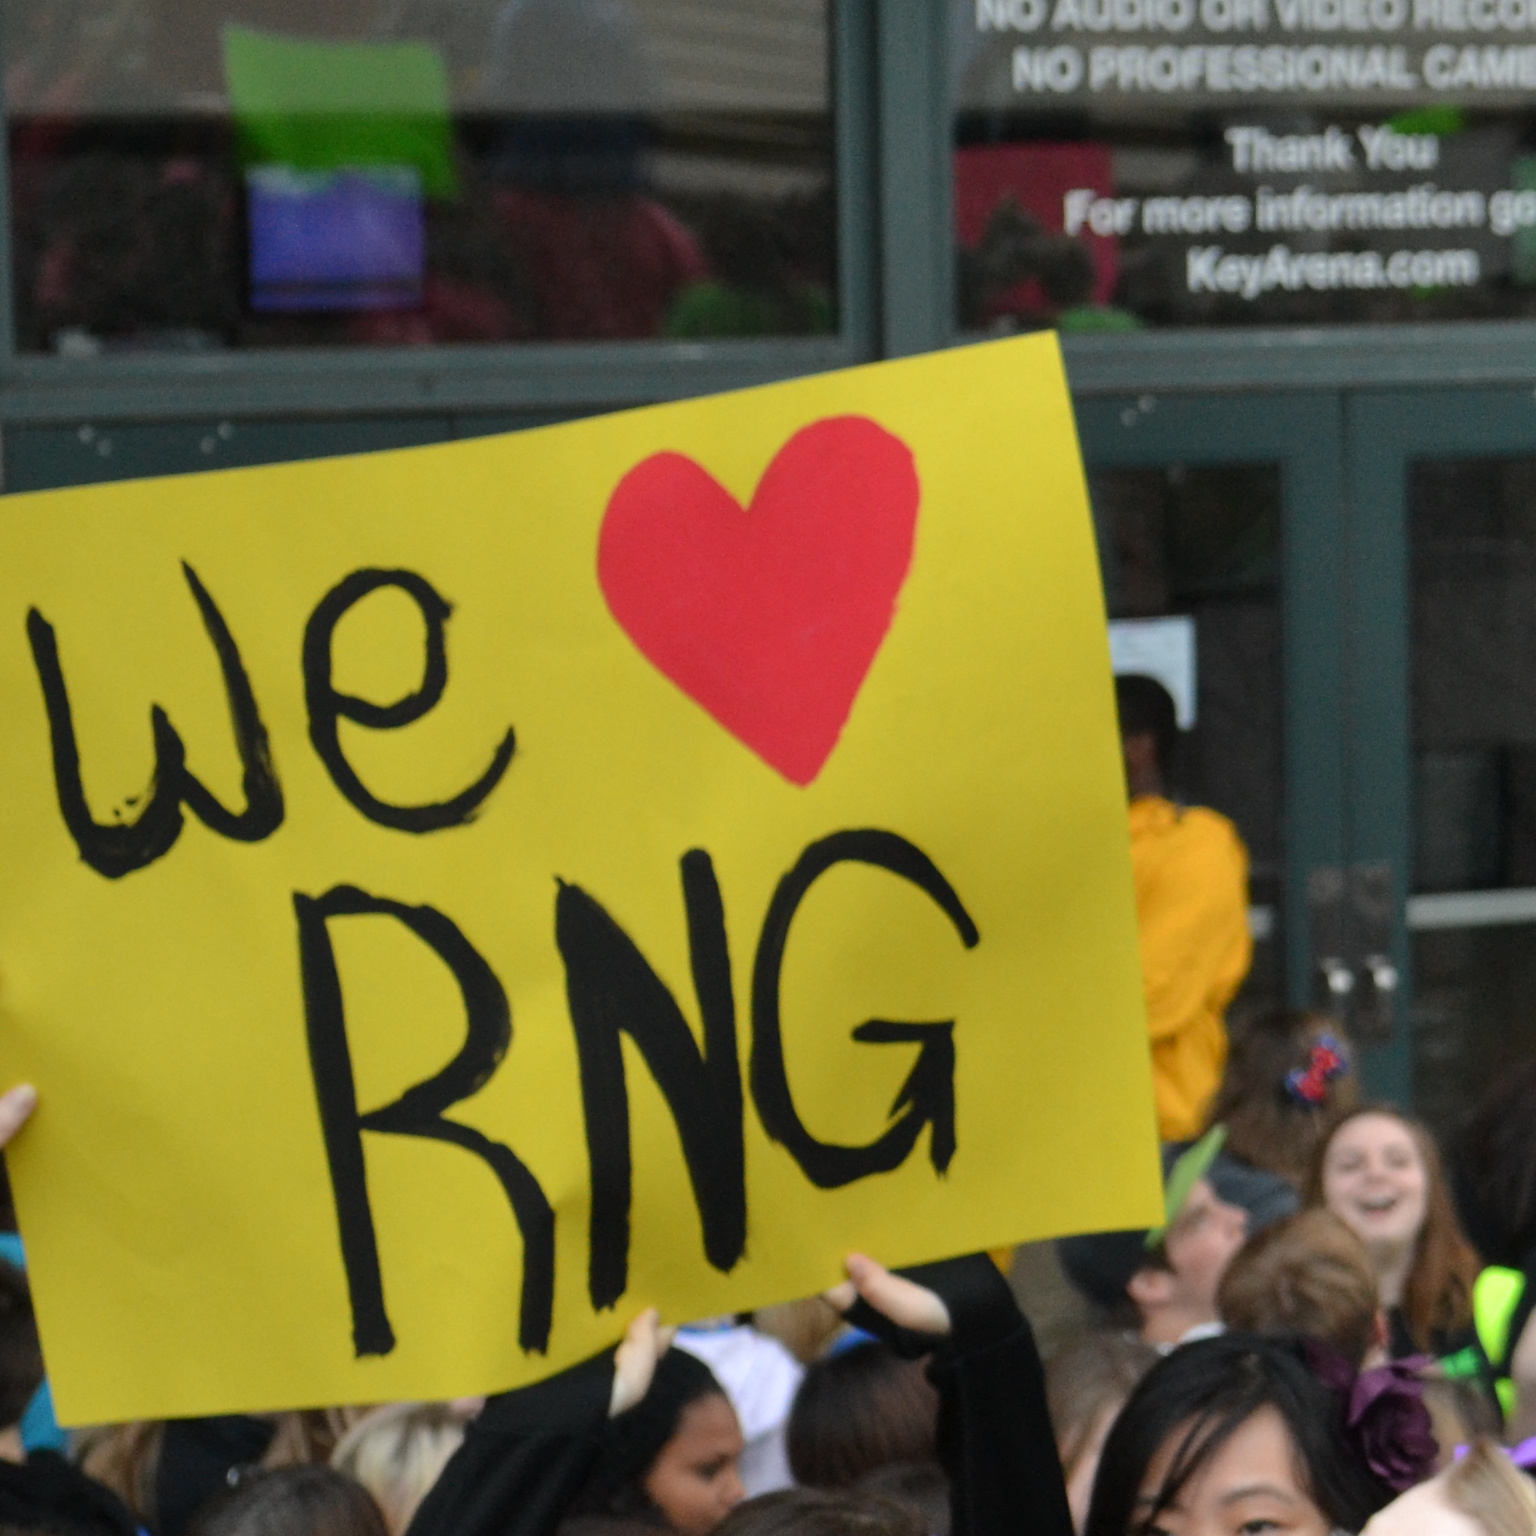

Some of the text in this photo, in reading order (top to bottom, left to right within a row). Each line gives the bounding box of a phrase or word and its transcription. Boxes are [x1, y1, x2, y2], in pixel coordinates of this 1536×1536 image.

[975, 0, 1047, 31] NO
[1051, 0, 1197, 31] AUDIO
[1202, 0, 1268, 31] OR
[1276, 0, 1406, 31] VIDEO
[1012, 47, 1081, 91] NO
[1088, 44, 1420, 91] PROFESSIONAL
[1225, 125, 1440, 172] Thank You
[1063, 189, 1138, 236] For
[1142, 196, 1249, 233] more
[1256, 185, 1485, 231] information
[1187, 246, 1480, 299] KeyArena.com
[293, 828, 980, 1359] RNG
